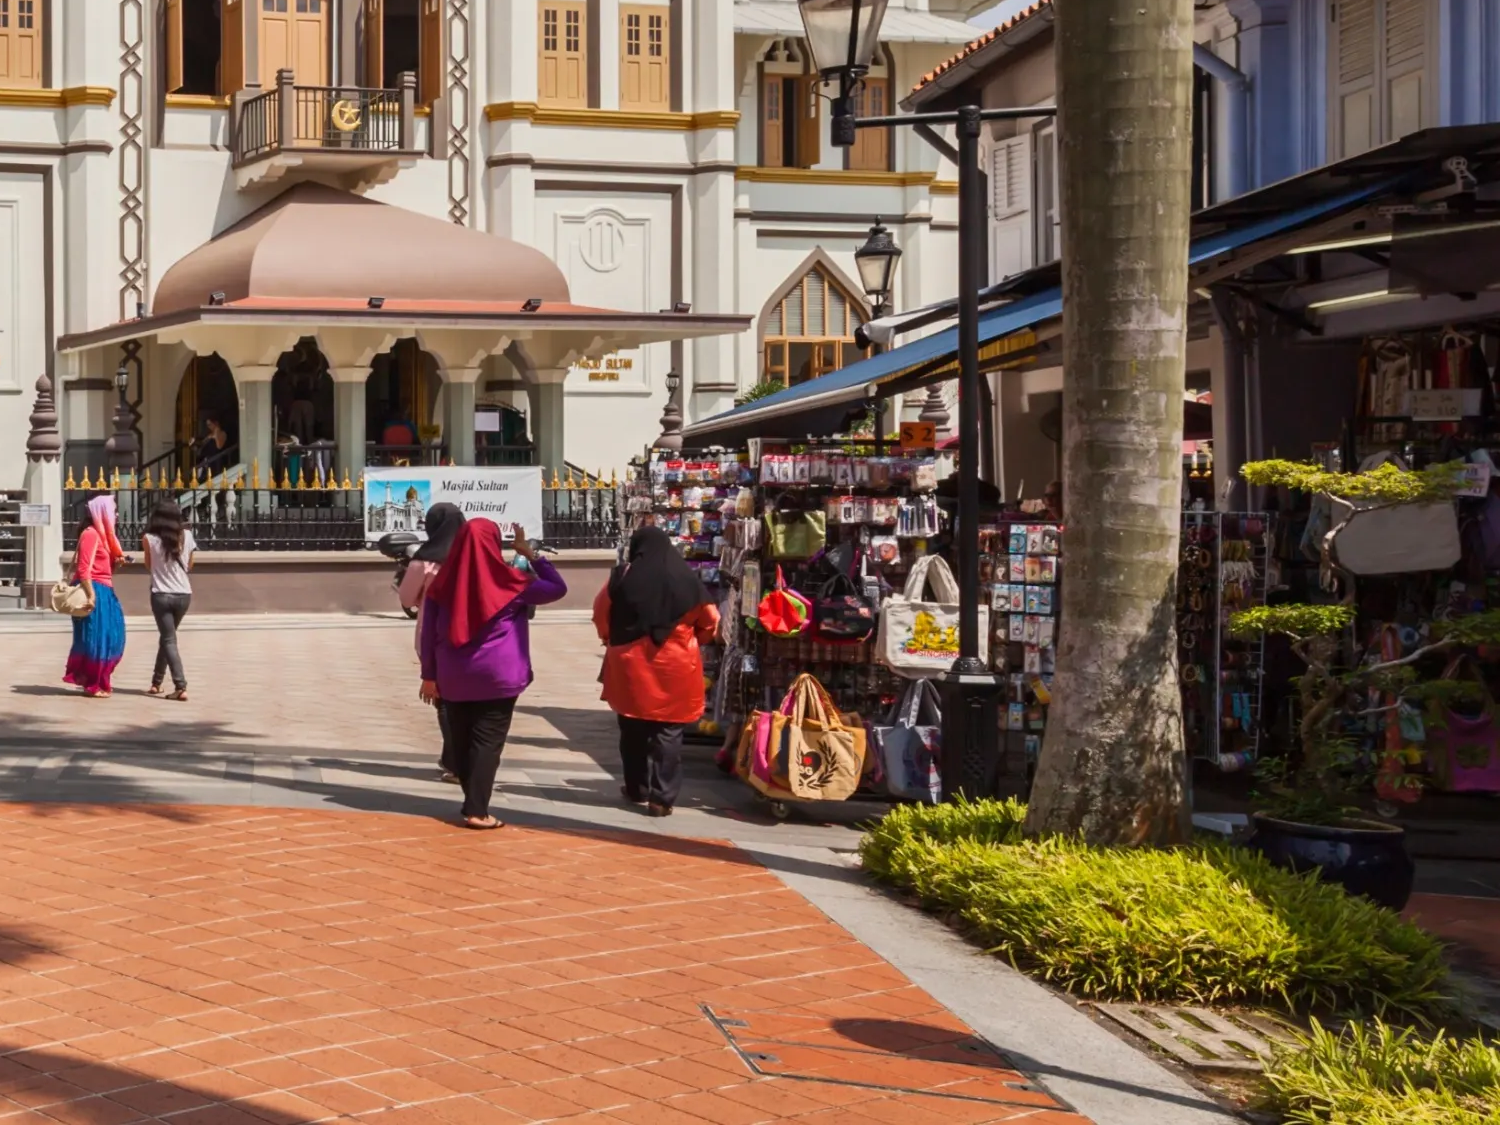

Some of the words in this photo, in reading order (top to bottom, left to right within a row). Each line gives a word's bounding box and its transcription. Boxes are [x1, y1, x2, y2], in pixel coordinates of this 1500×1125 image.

[440, 480, 474, 493] Masjid
[477, 480, 508, 491] Sultan
[464, 501, 508, 513] Diiktiraf
